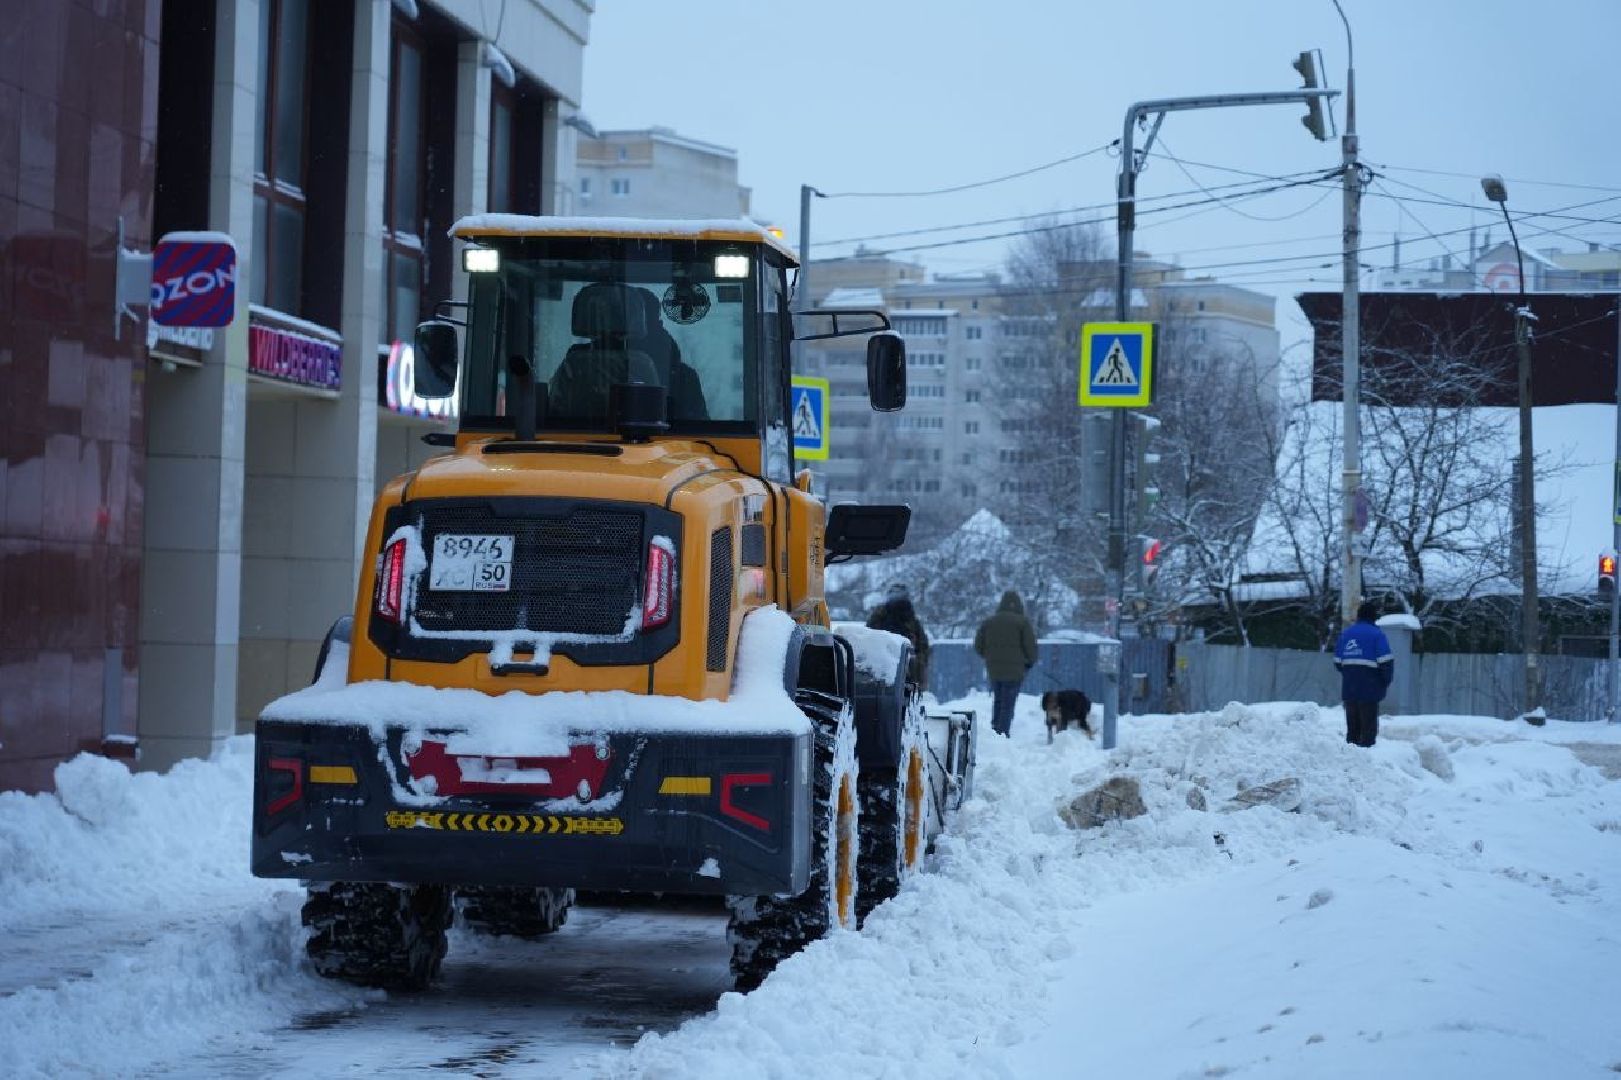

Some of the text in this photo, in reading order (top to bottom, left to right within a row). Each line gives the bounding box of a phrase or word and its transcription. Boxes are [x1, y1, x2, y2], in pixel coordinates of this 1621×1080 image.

[151, 264, 236, 308] OZON
[444, 537, 503, 559] 8946
[482, 564, 506, 581] 50
